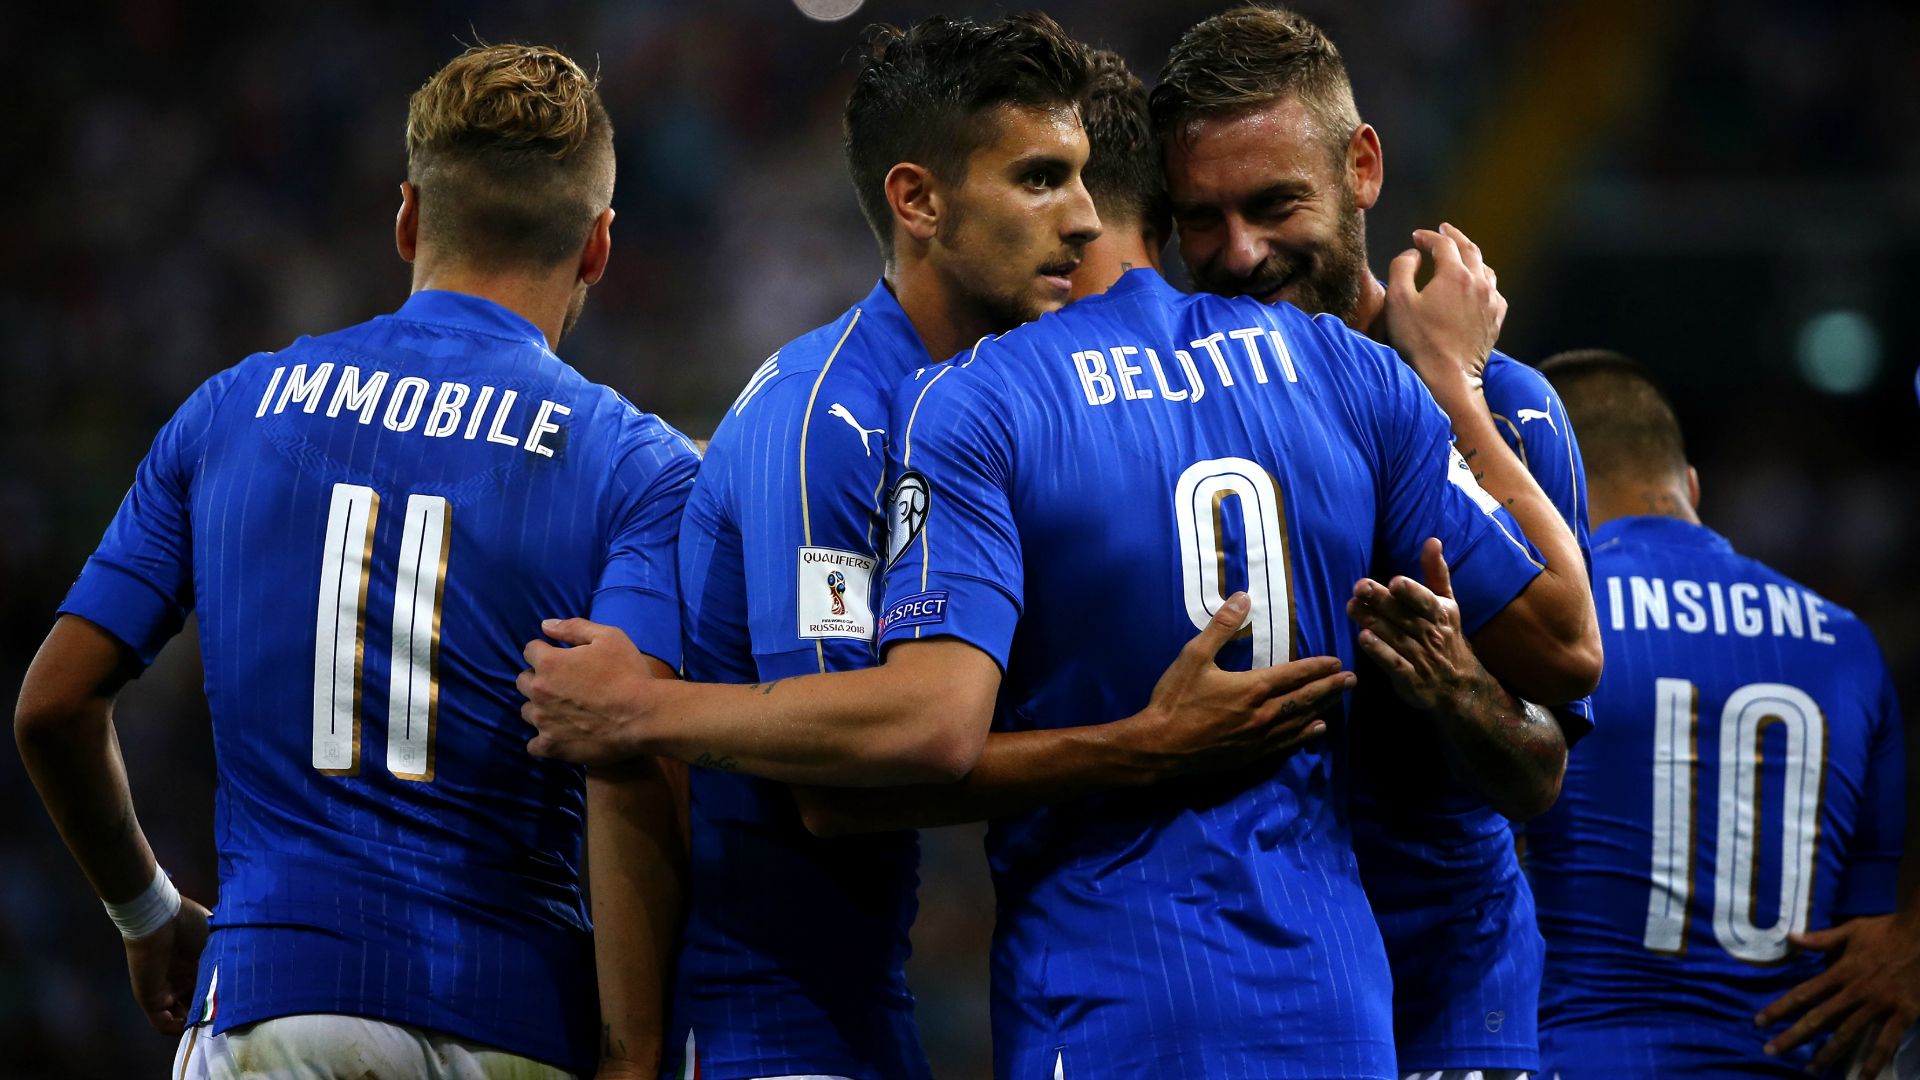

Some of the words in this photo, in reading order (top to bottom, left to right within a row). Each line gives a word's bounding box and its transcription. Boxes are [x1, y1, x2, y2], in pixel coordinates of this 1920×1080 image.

[255, 362, 572, 458] IMMOBILE
[803, 552, 871, 570] QUALIFIERS
[1174, 457, 1298, 669] 9
[312, 483, 453, 782] 11
[810, 624, 845, 632] RUSSIA
[846, 625, 864, 633] 2018
[1607, 576, 1836, 645] INSIGNE
[1643, 677, 1830, 964] 10
